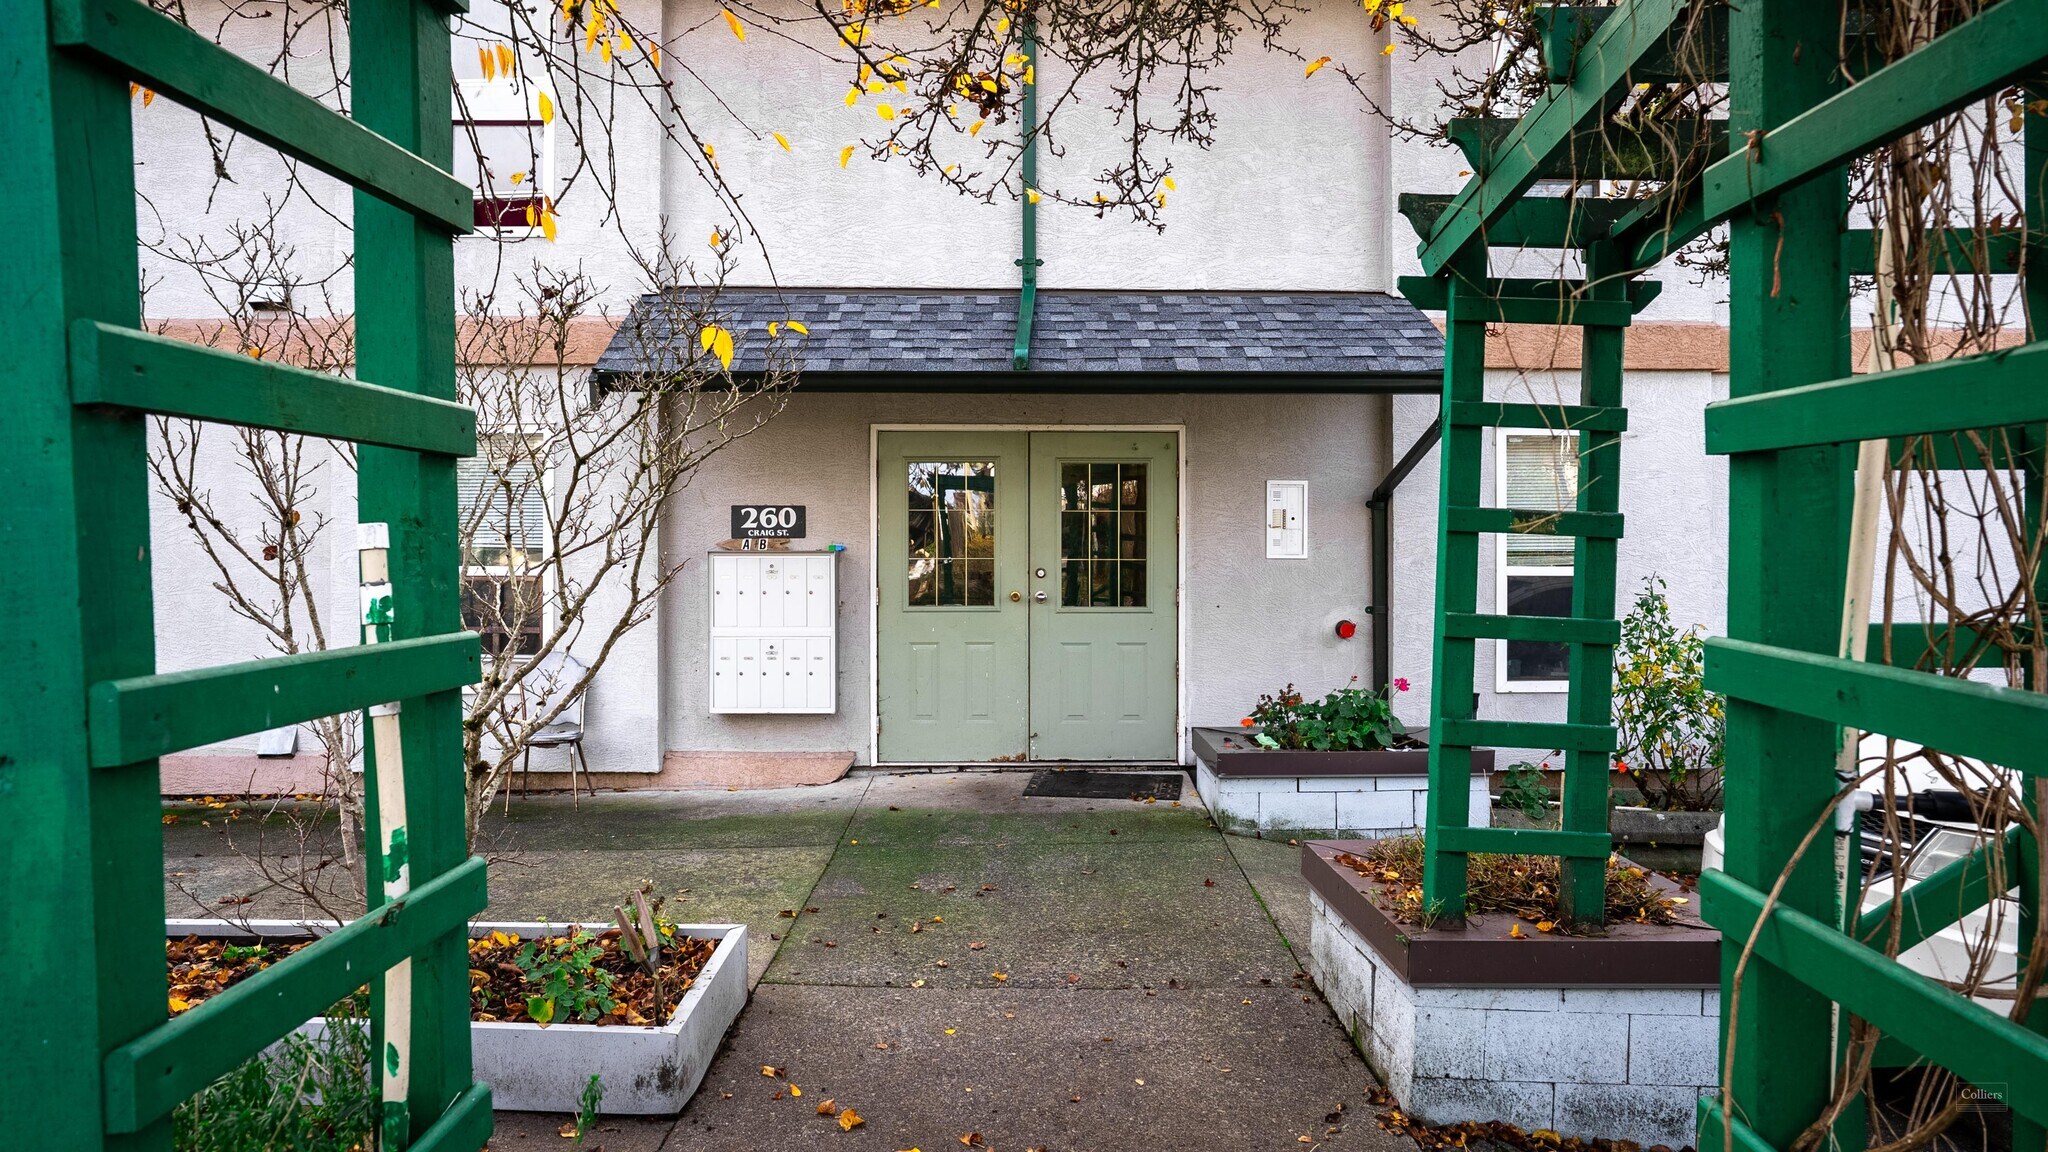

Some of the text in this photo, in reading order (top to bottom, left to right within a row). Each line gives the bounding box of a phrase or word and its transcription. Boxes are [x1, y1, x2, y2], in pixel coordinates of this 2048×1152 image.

[740, 507, 797, 529] 260
[742, 539, 767, 550] A B
